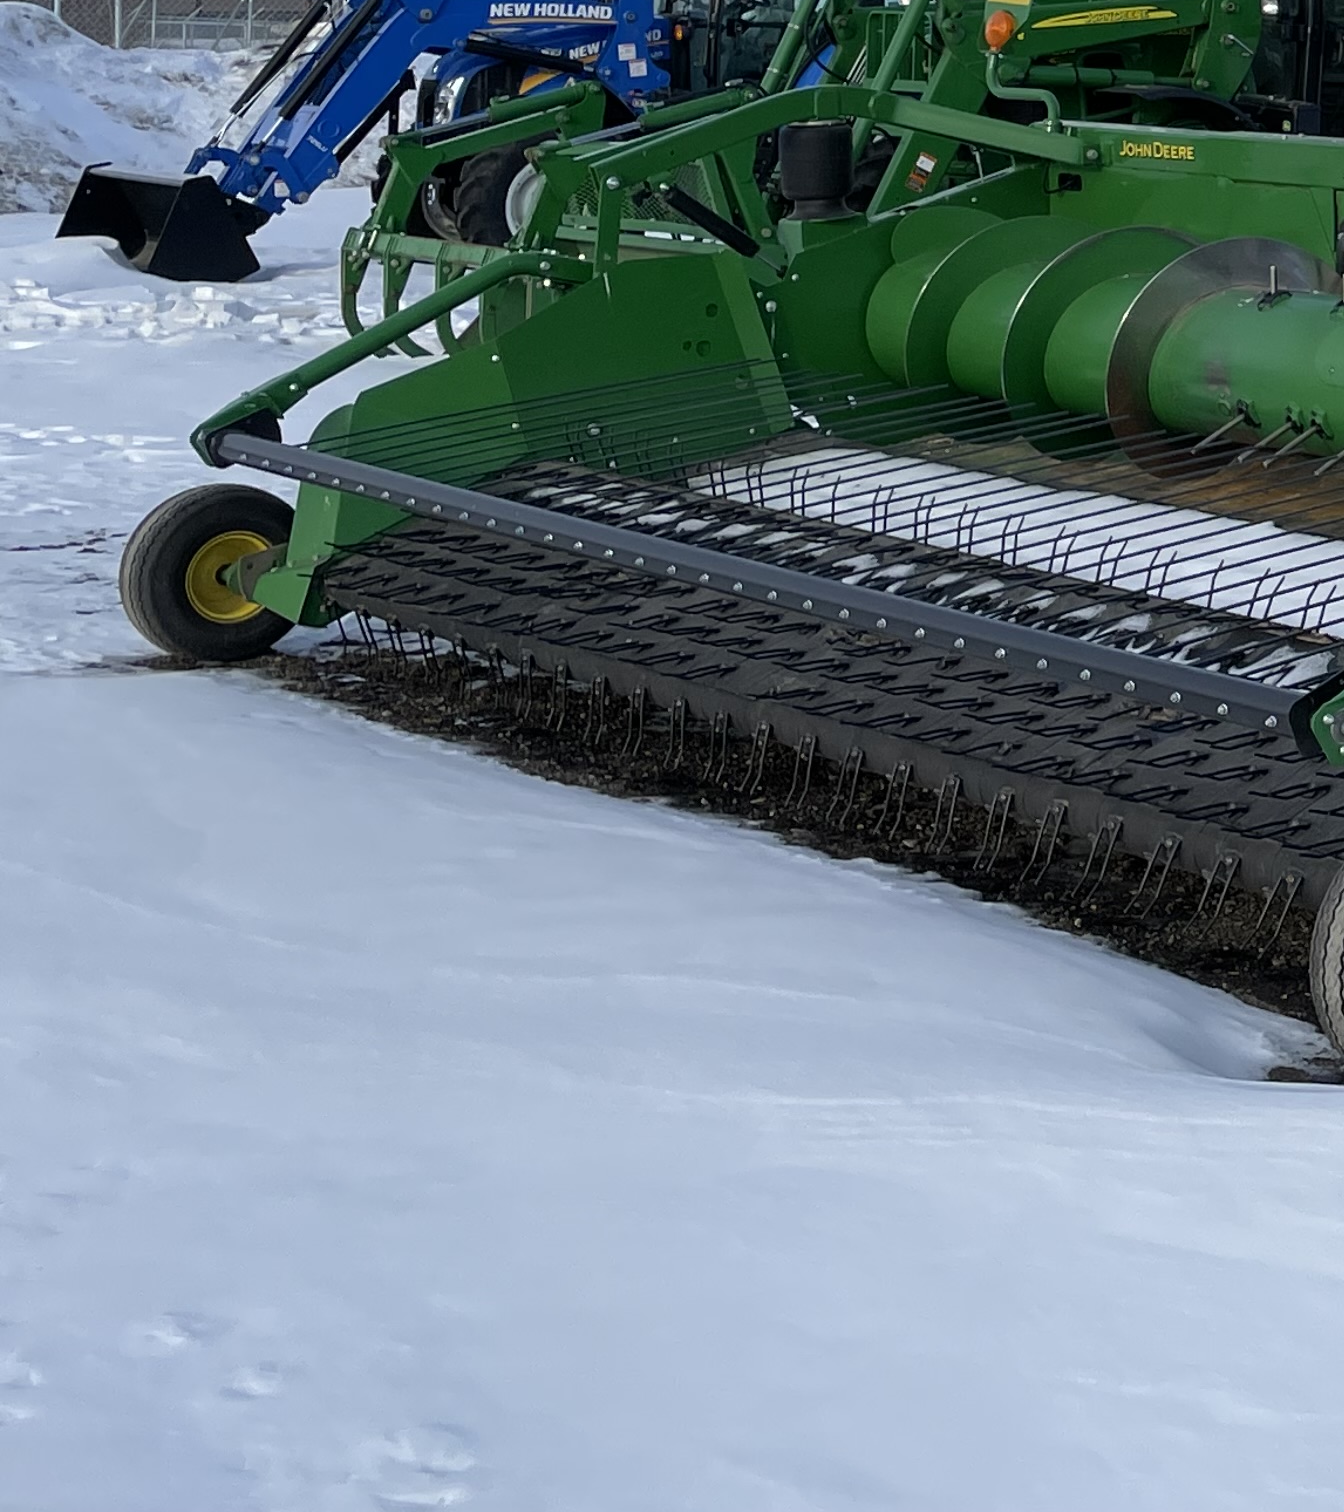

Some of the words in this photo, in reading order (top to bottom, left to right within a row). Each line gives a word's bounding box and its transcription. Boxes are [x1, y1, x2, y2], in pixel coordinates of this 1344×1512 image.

[490, 3, 531, 17] NEW
[534, 3, 612, 19] HOLLAND
[569, 41, 601, 60] NEW
[1119, 140, 1152, 157] JOHN
[1153, 142, 1195, 160] DEERE
